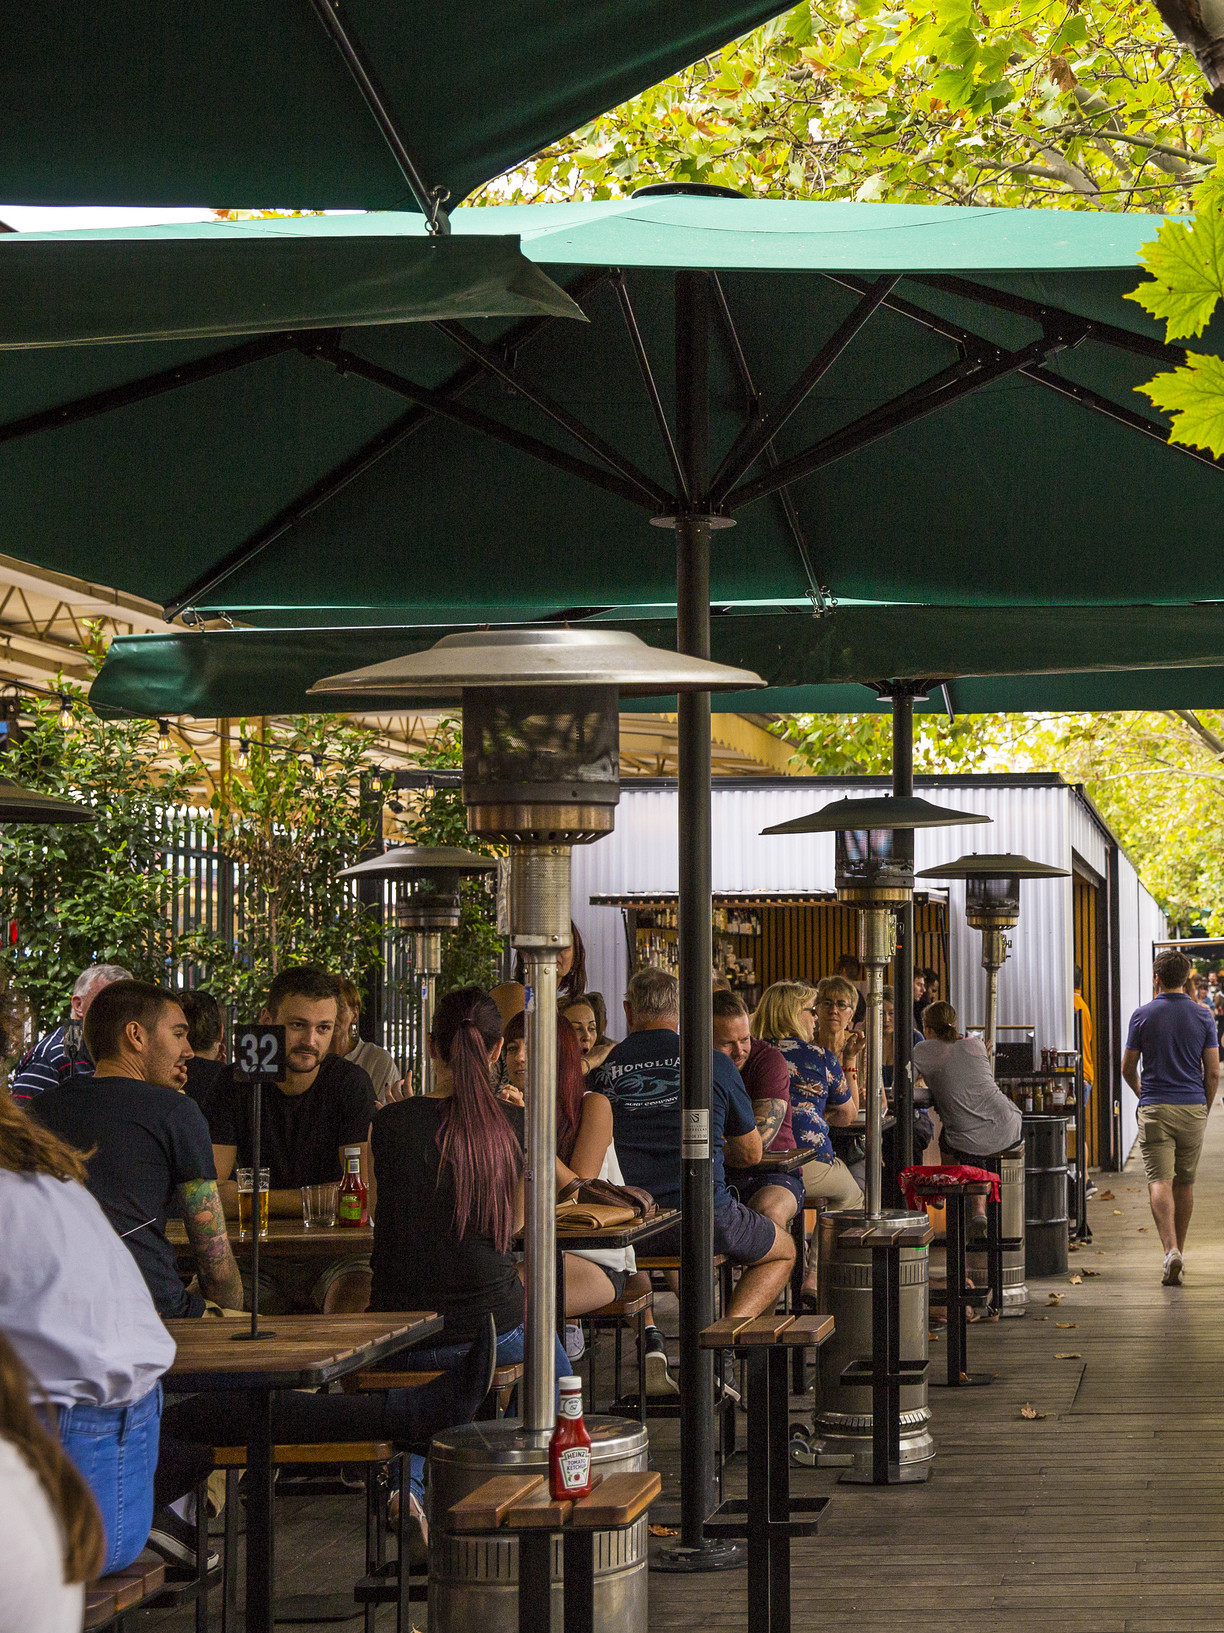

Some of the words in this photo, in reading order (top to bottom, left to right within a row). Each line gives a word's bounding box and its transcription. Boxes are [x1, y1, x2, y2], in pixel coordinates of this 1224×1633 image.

[240, 1033, 278, 1073] 32
[611, 1057, 680, 1080] HONOLUA
[644, 1096, 678, 1106] COMPANY
[567, 1451, 586, 1459] HEINZ
